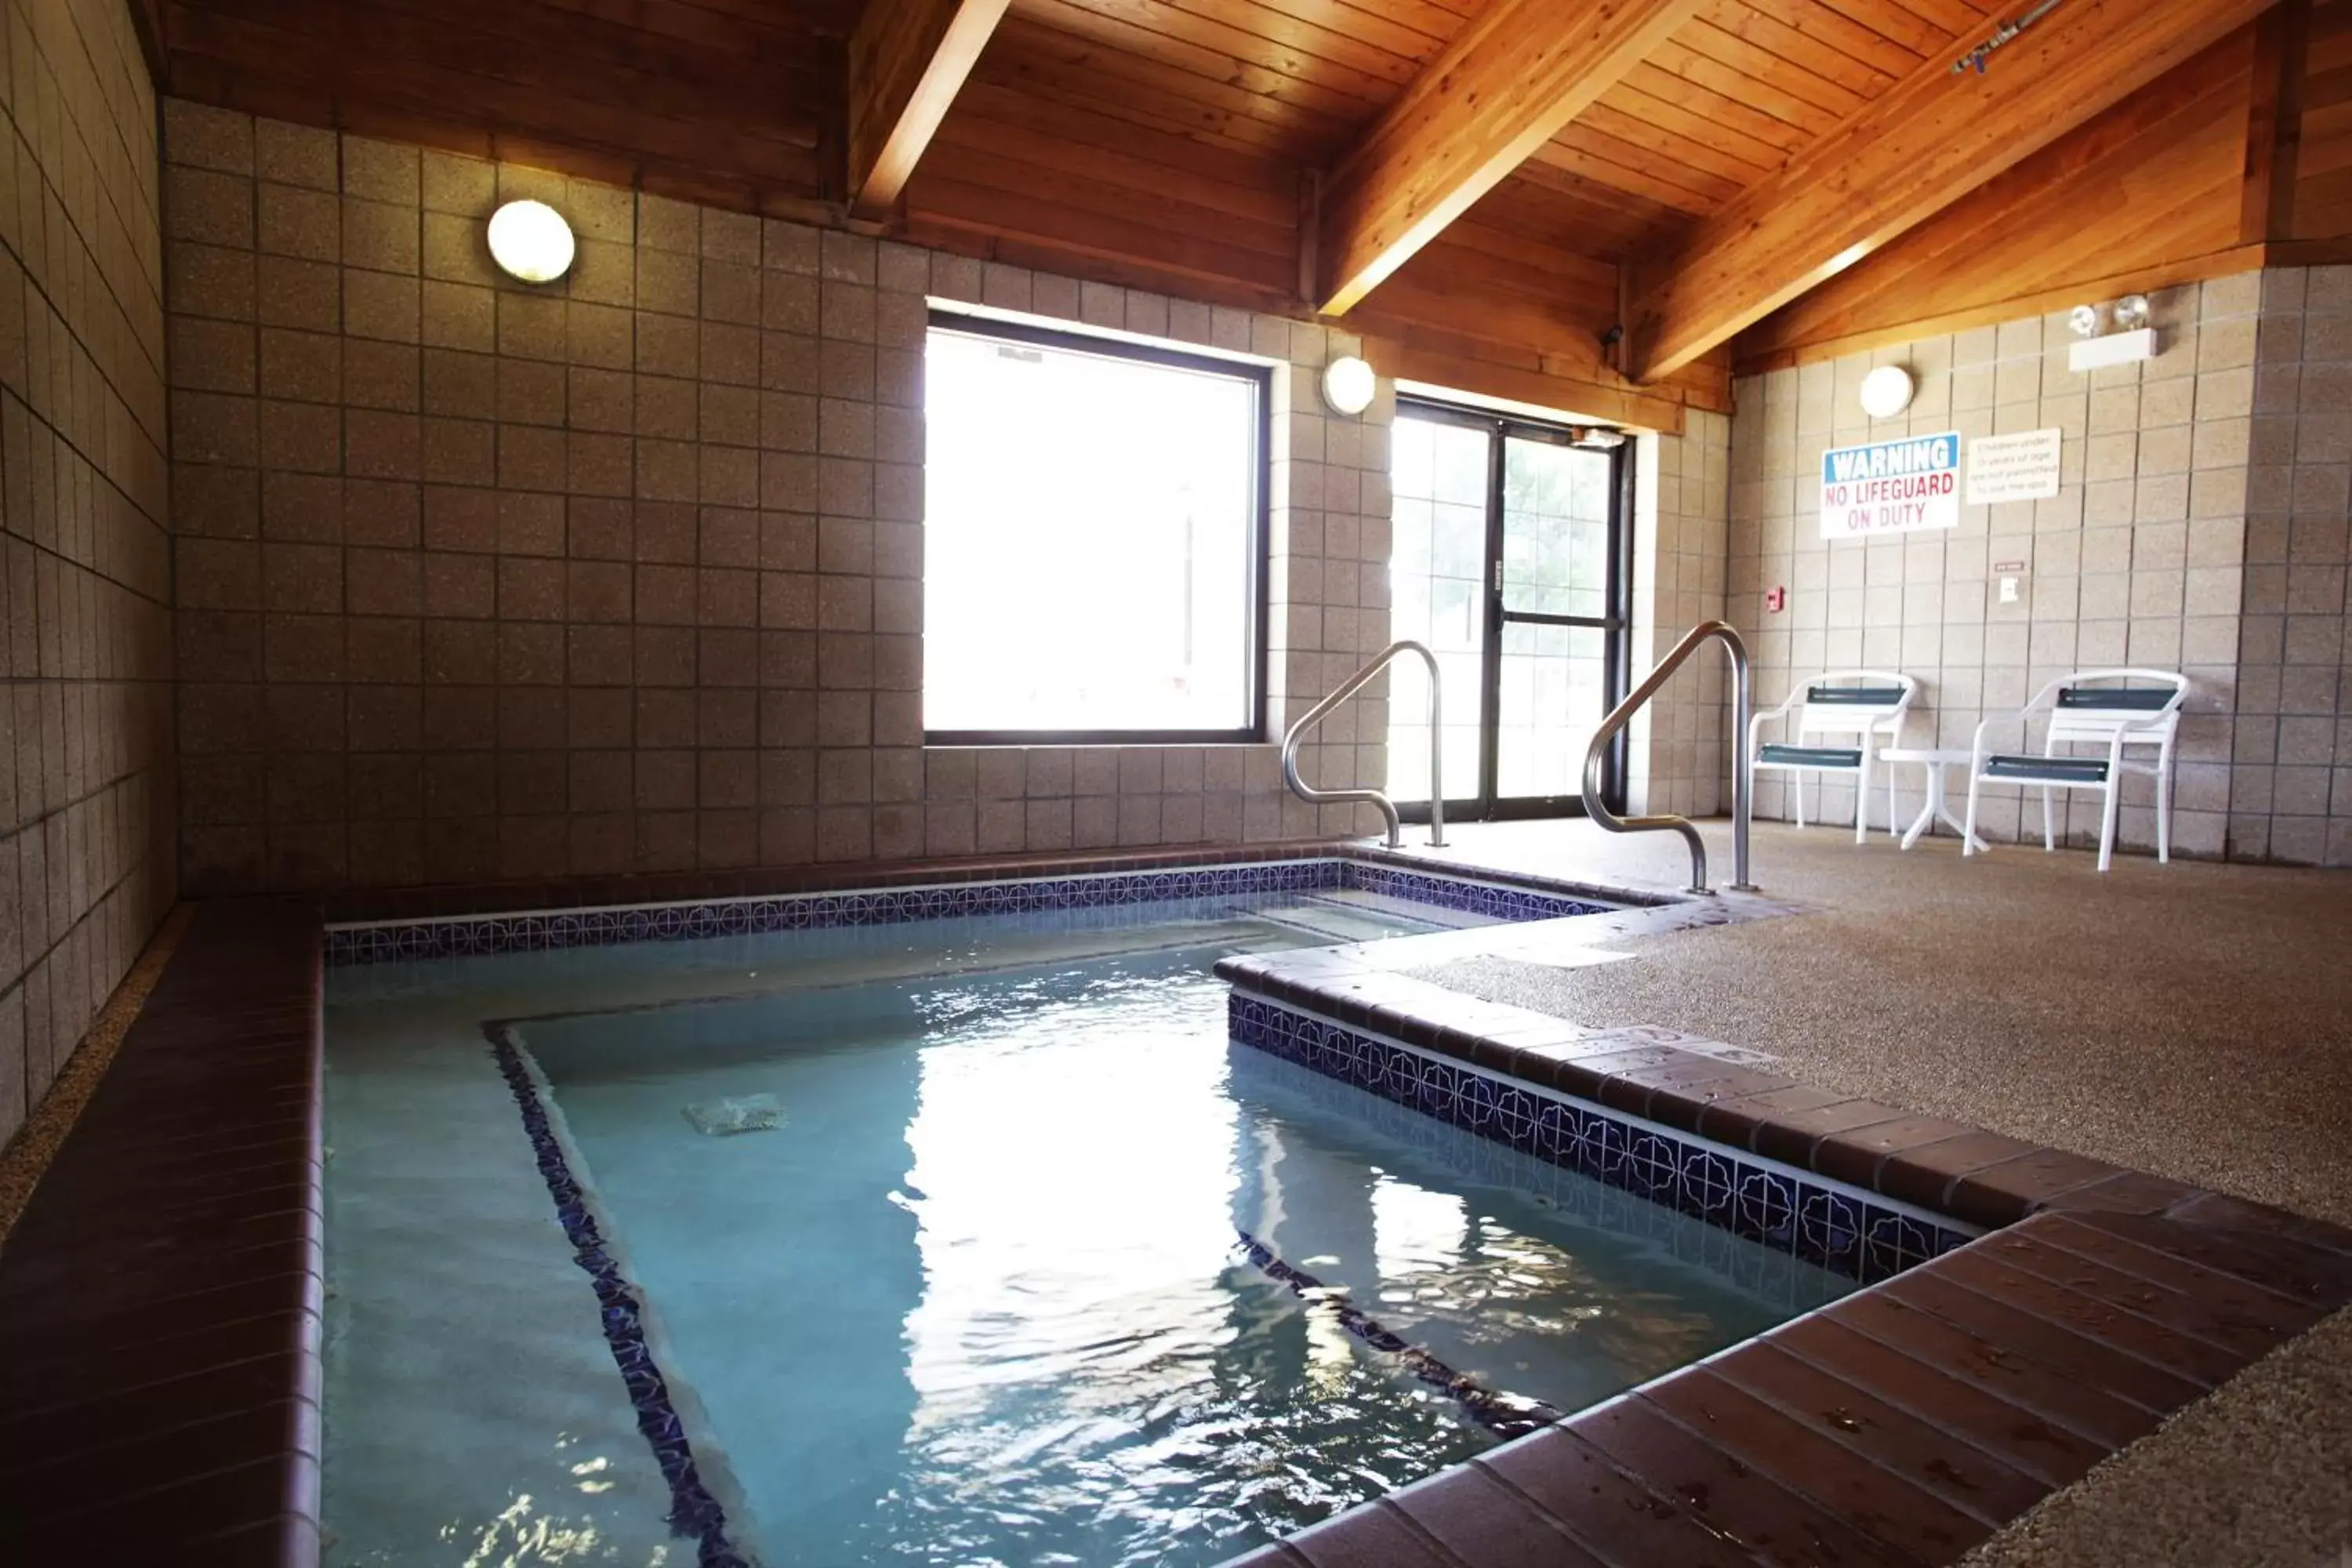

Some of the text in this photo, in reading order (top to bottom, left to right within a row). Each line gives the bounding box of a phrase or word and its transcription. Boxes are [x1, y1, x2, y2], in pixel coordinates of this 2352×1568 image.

[1832, 438, 1950, 483] WARNING
[1825, 485, 1848, 507] NO
[1856, 472, 1954, 504] LIFEGUARD
[1848, 502, 1926, 531] ON DUTY
